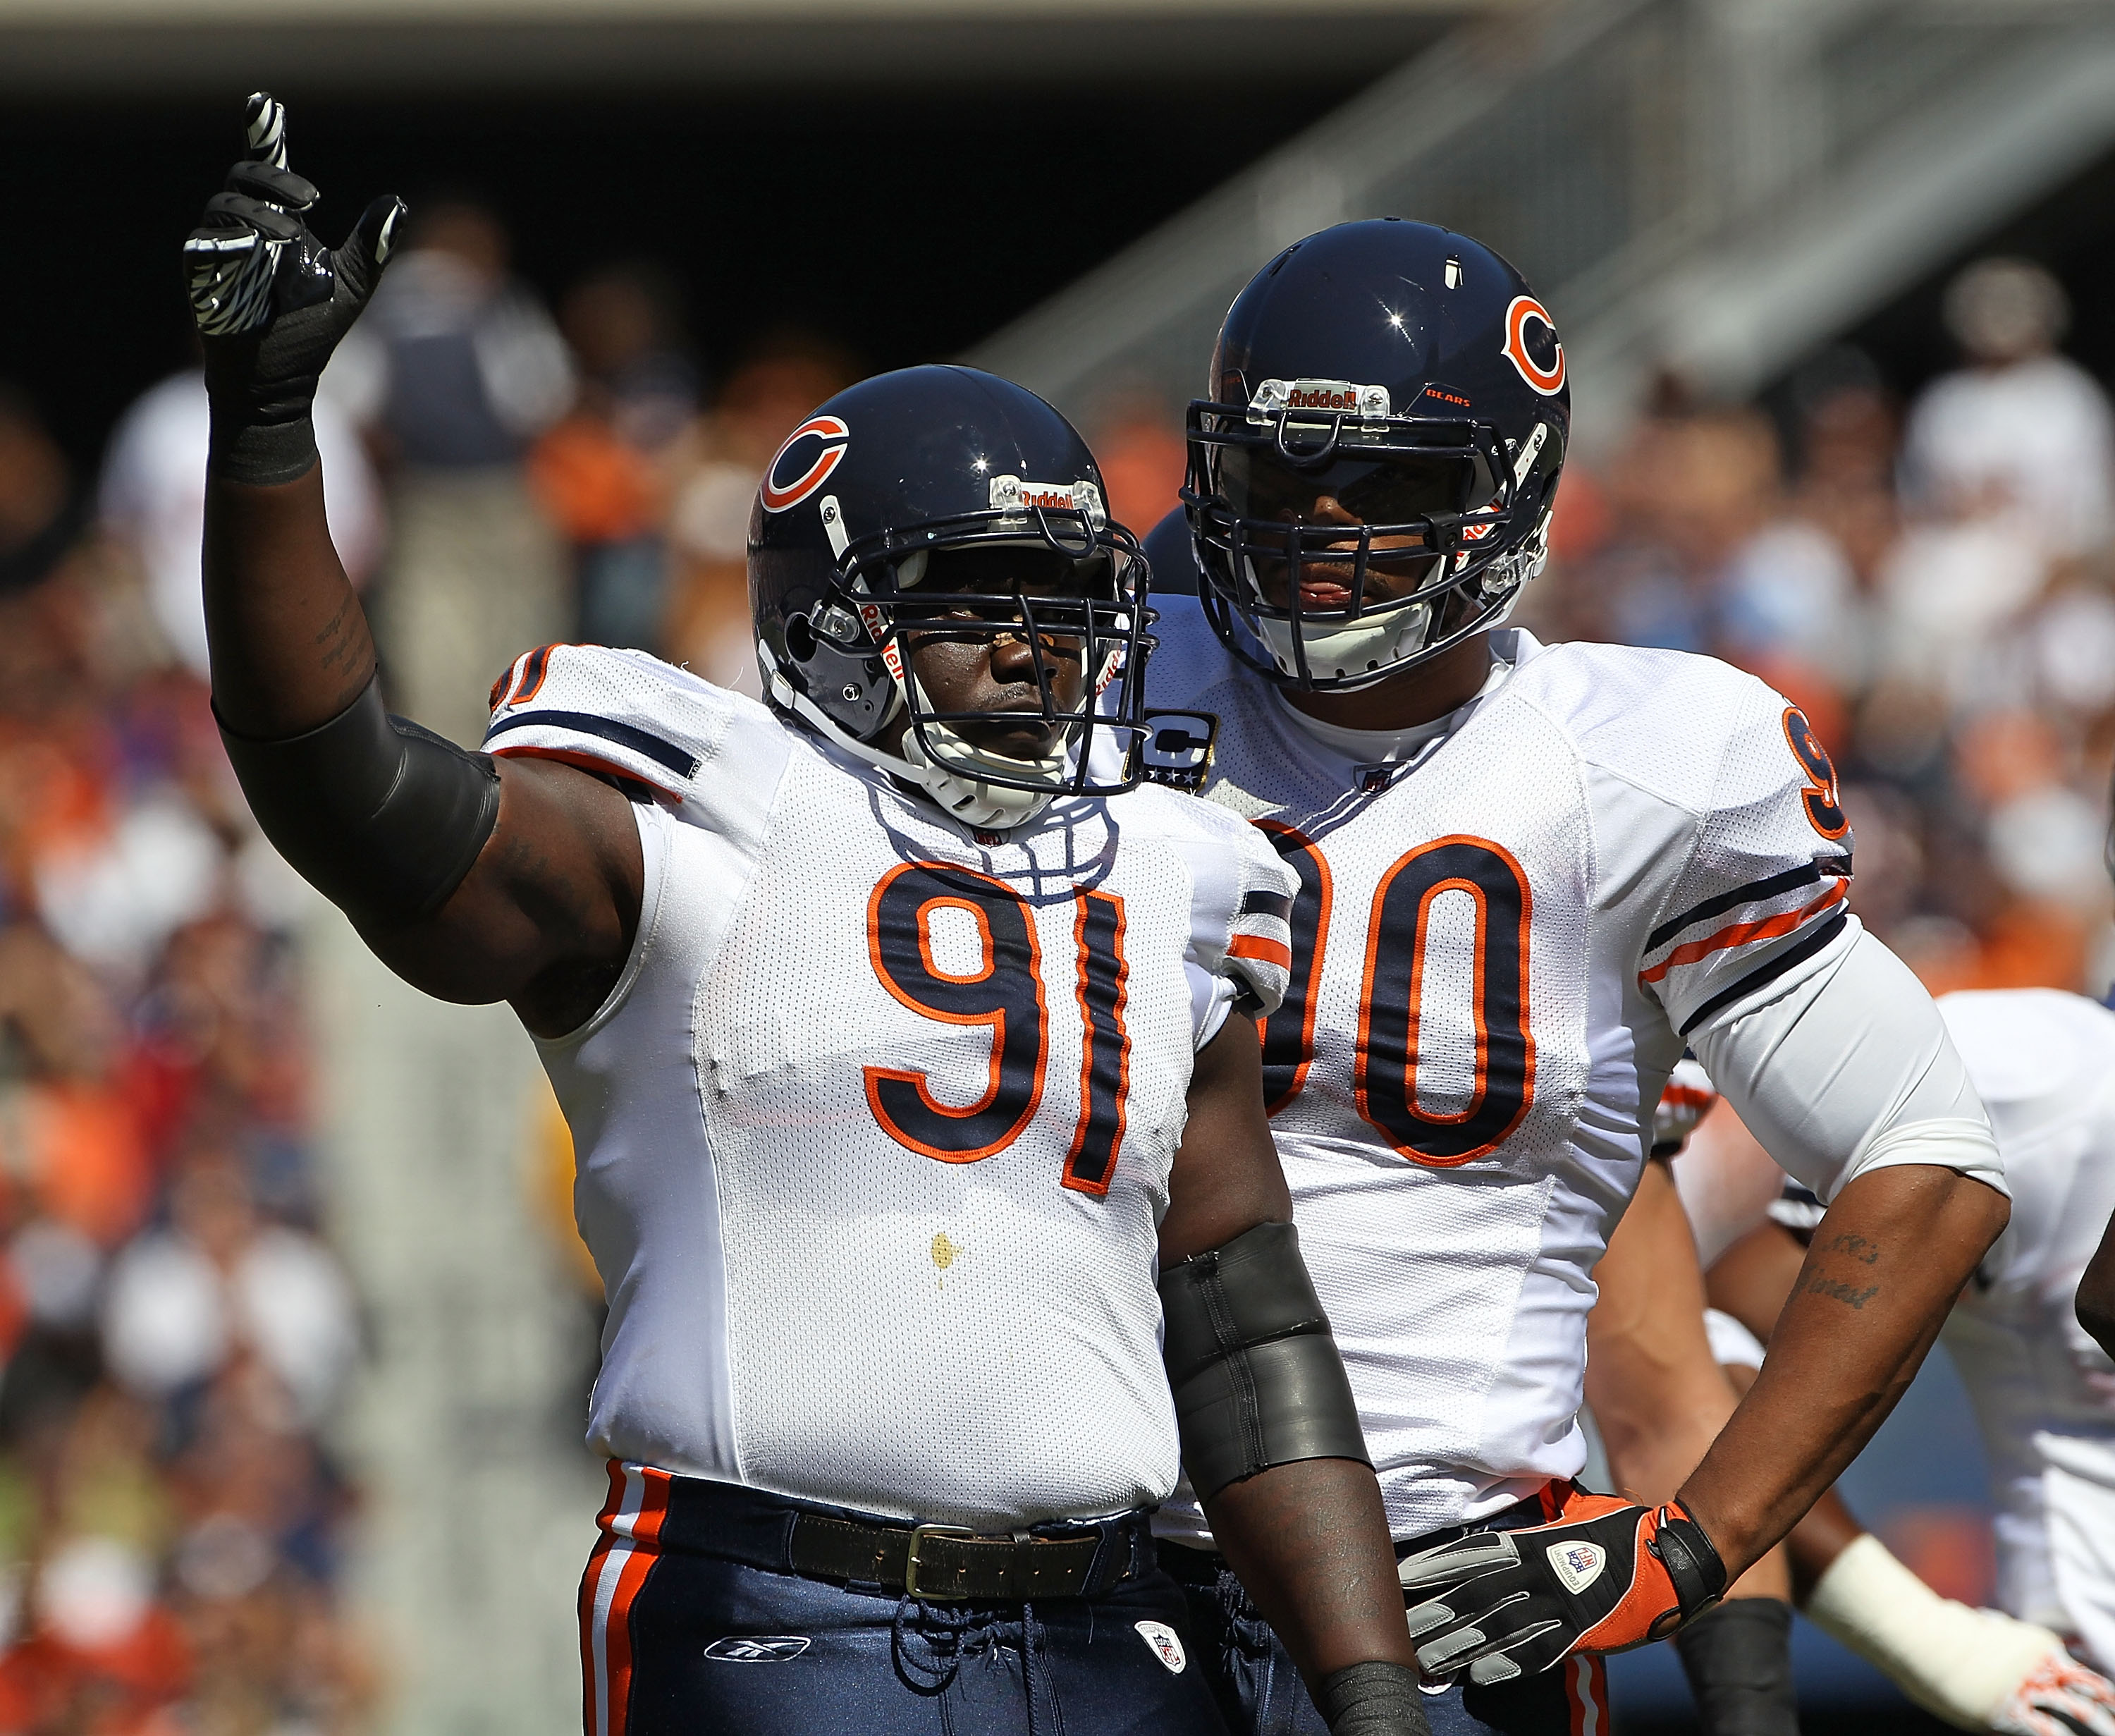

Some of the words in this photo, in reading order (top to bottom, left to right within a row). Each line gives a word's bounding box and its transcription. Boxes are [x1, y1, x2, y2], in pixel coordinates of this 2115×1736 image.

[1501, 295, 1567, 396] C
[1288, 389, 1356, 410] Riddell
[1426, 389, 1471, 408] BEARS
[760, 415, 850, 513] C
[1020, 491, 1074, 510] Riddell
[1142, 715, 1210, 769] C
[864, 860, 1132, 1196] 91
[1577, 1548, 1595, 1567] NFL
